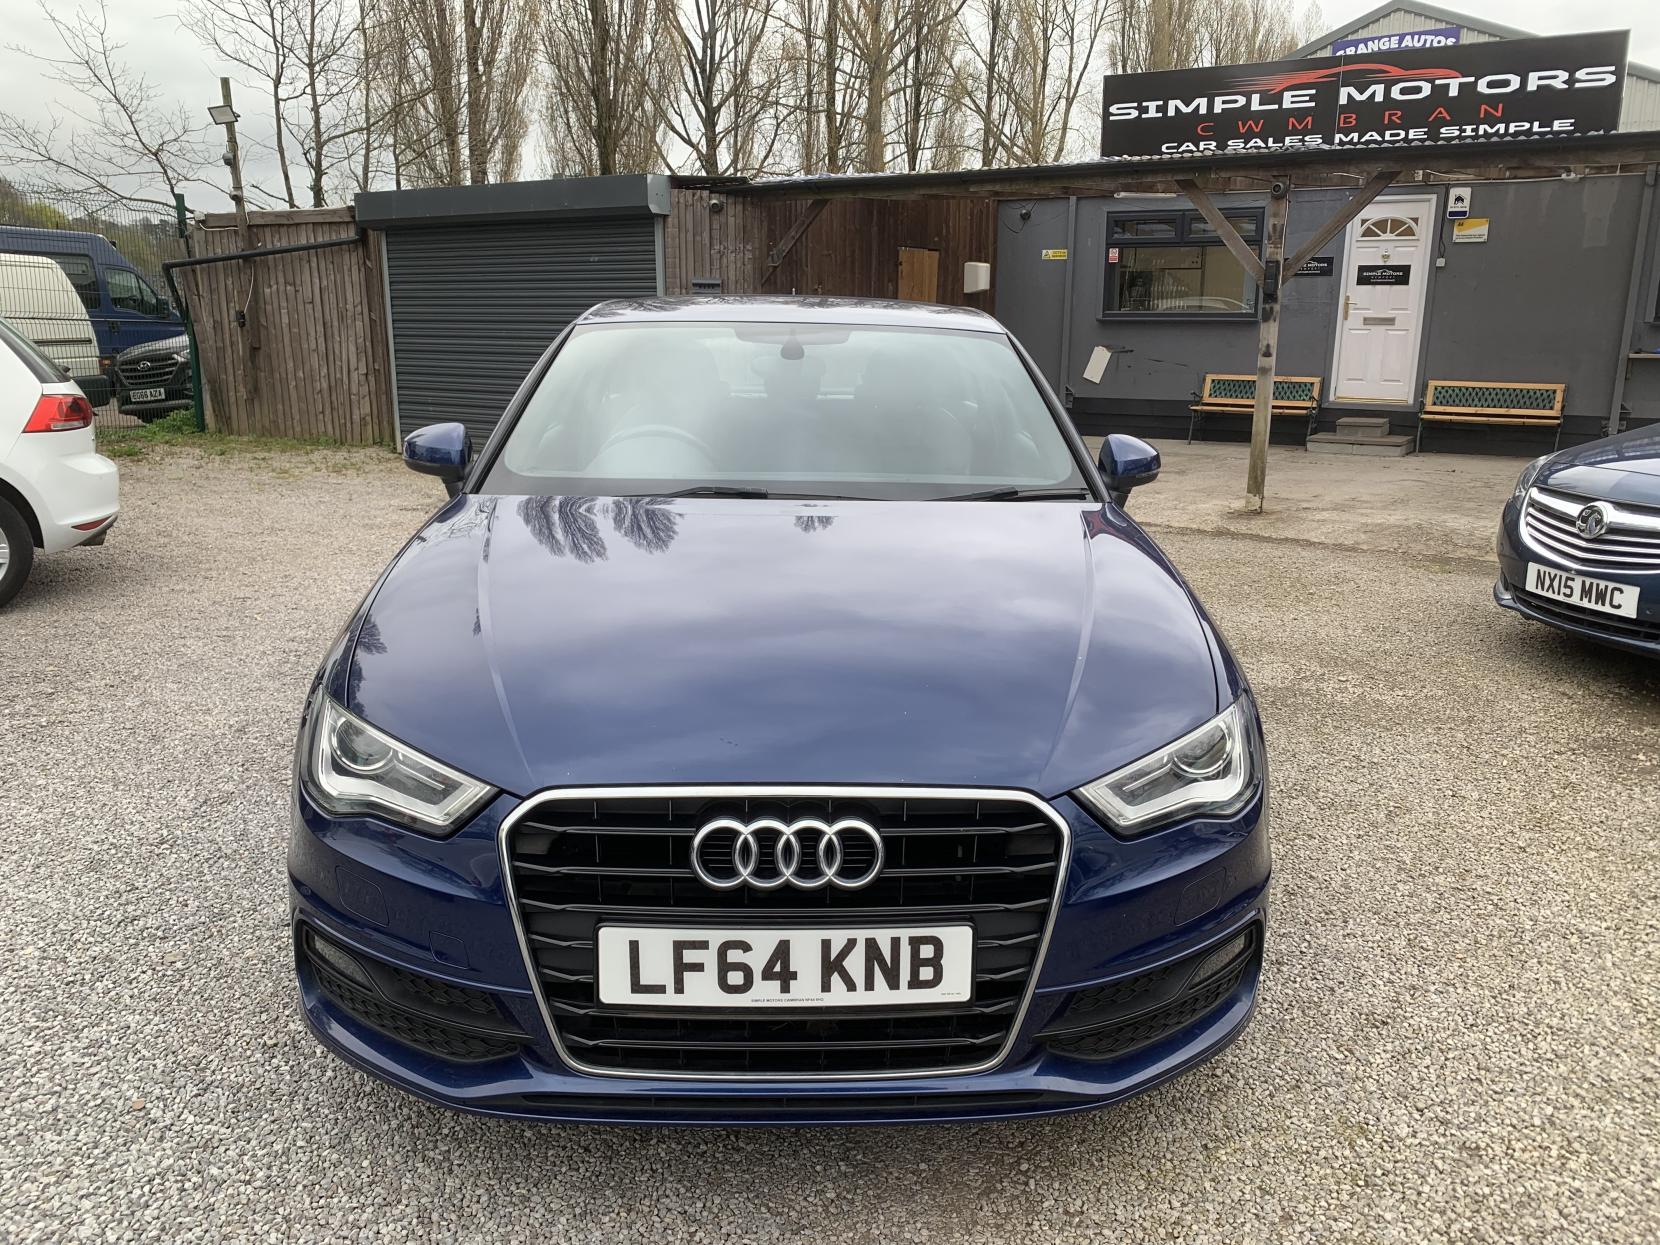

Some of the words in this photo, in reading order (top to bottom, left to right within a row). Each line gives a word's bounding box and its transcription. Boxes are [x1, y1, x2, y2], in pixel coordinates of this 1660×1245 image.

[1109, 89, 1316, 121] SIMPLE
[1338, 65, 1617, 105] MOTORS
[1161, 140, 1217, 153] CAR
[1227, 134, 1323, 150] SALES
[1334, 127, 1428, 145] MADE
[1440, 119, 1575, 138] SIMPLE
[1197, 103, 1504, 136] CWMBRAN
[1535, 568, 1575, 598] NX15
[1580, 579, 1624, 610] MWC
[628, 939, 798, 995] LF64
[820, 935, 944, 994] KNB
